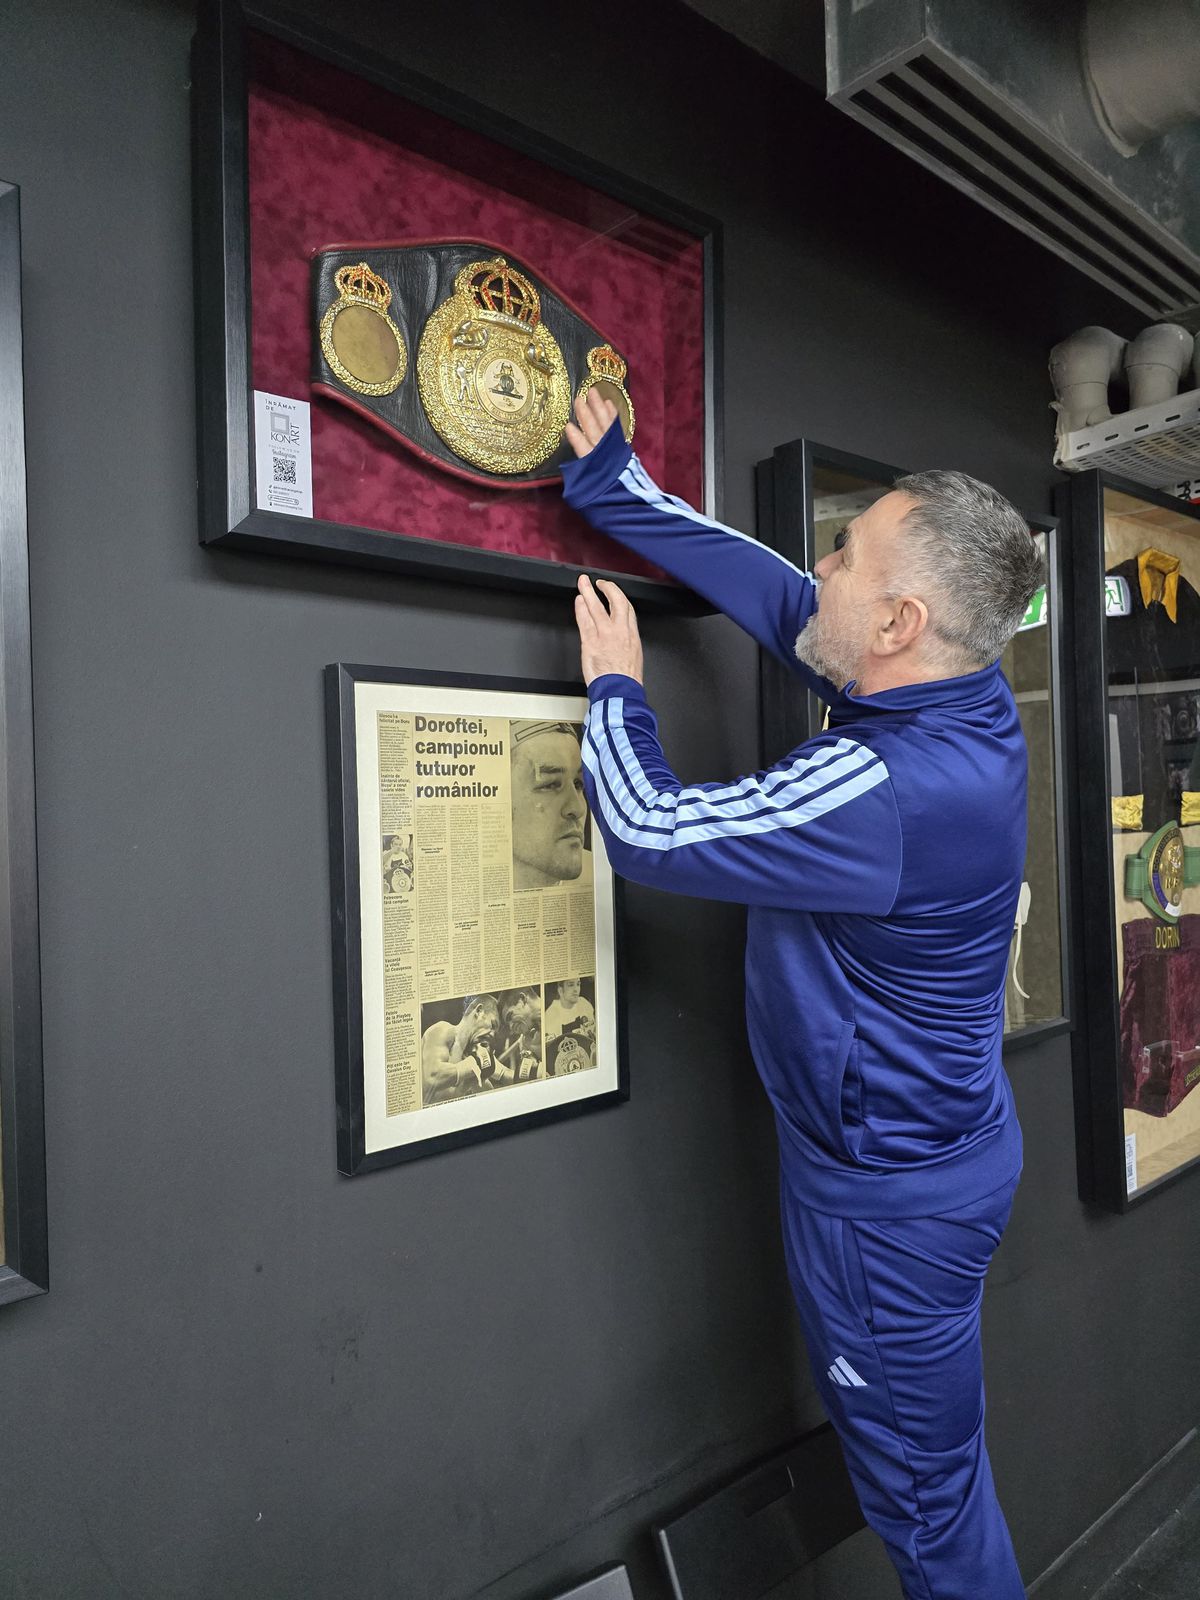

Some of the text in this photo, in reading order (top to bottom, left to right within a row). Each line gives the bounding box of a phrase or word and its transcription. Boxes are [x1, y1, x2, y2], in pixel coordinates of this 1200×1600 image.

[415, 715, 488, 737] Doroftei,
[415, 739, 503, 759] campionul
[416, 760, 476, 776] tuturor
[416, 781, 498, 798] românilor
[1155, 926, 1180, 949] DORIN
